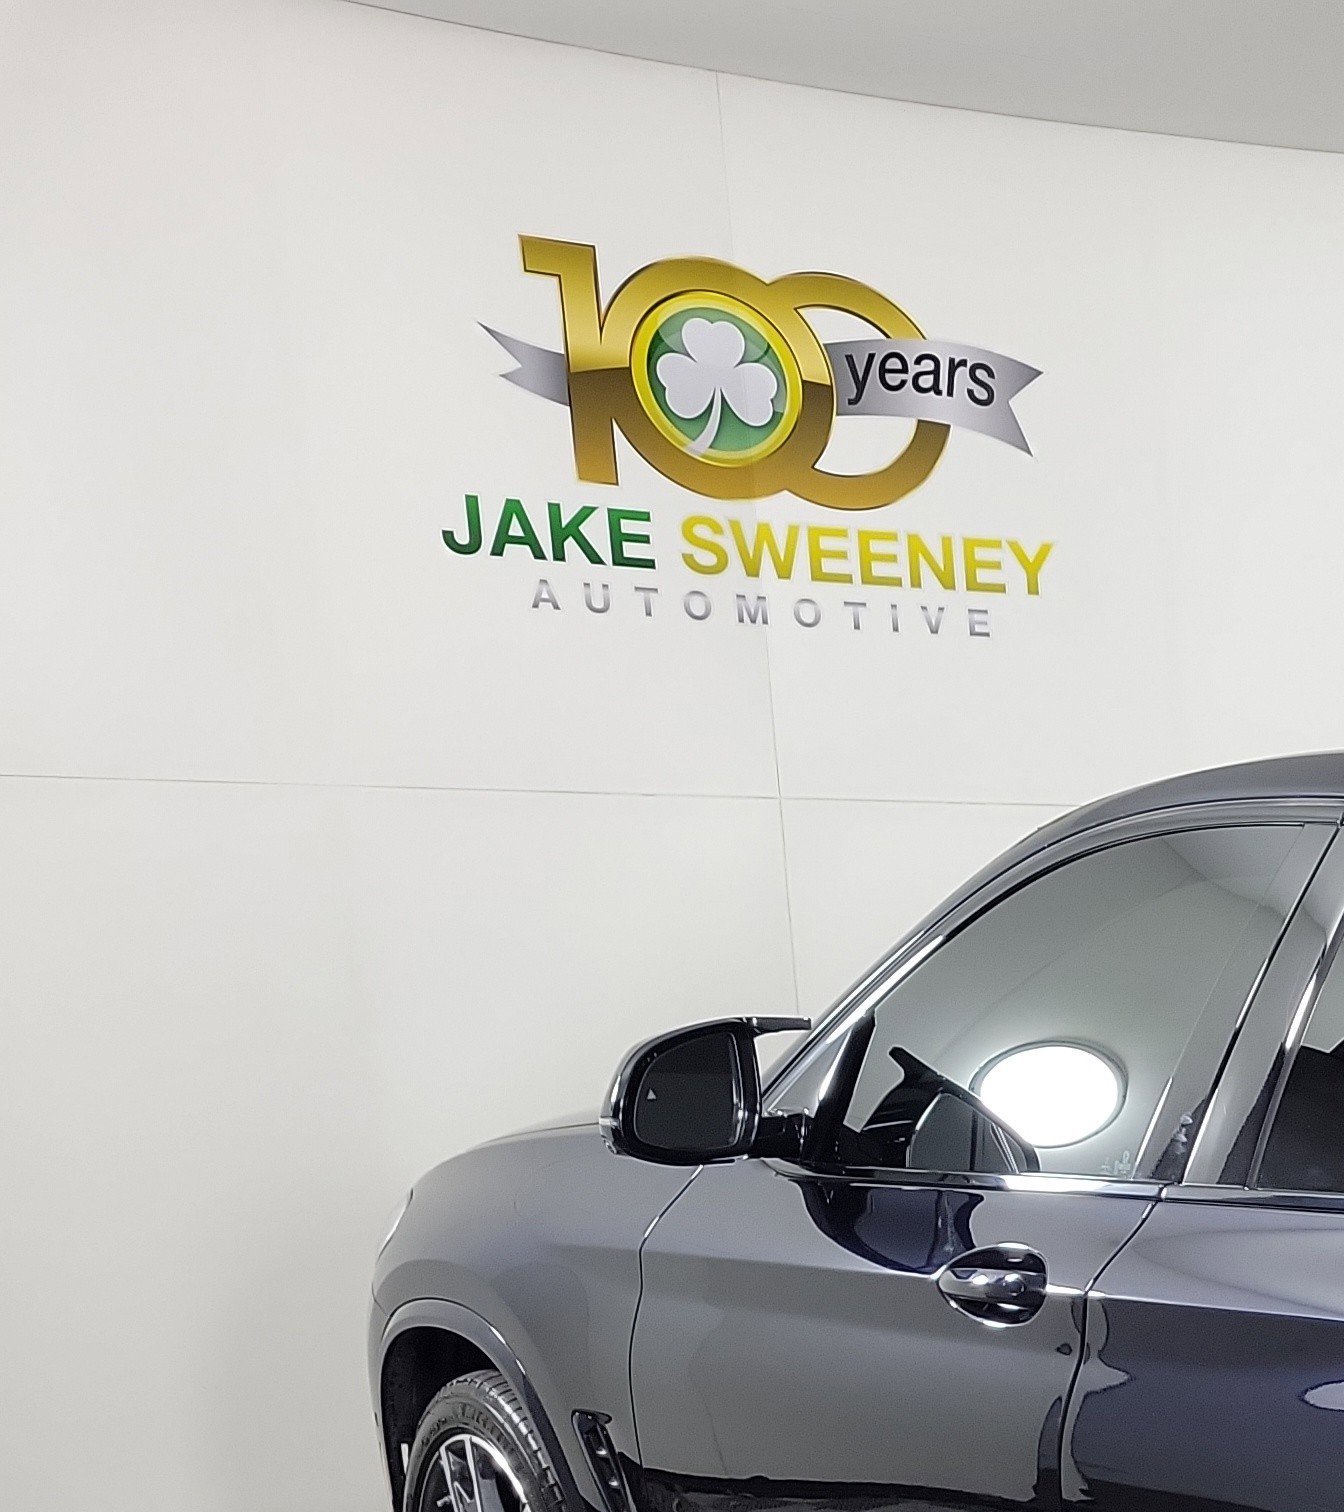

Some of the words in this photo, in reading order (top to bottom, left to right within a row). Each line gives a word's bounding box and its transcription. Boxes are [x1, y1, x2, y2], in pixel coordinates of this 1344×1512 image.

[519, 234, 950, 511] 100
[844, 352, 996, 407] years
[441, 494, 657, 571] JAKE
[680, 519, 1053, 595] SWEENEY
[532, 579, 991, 637] AUTOMOTIVE
